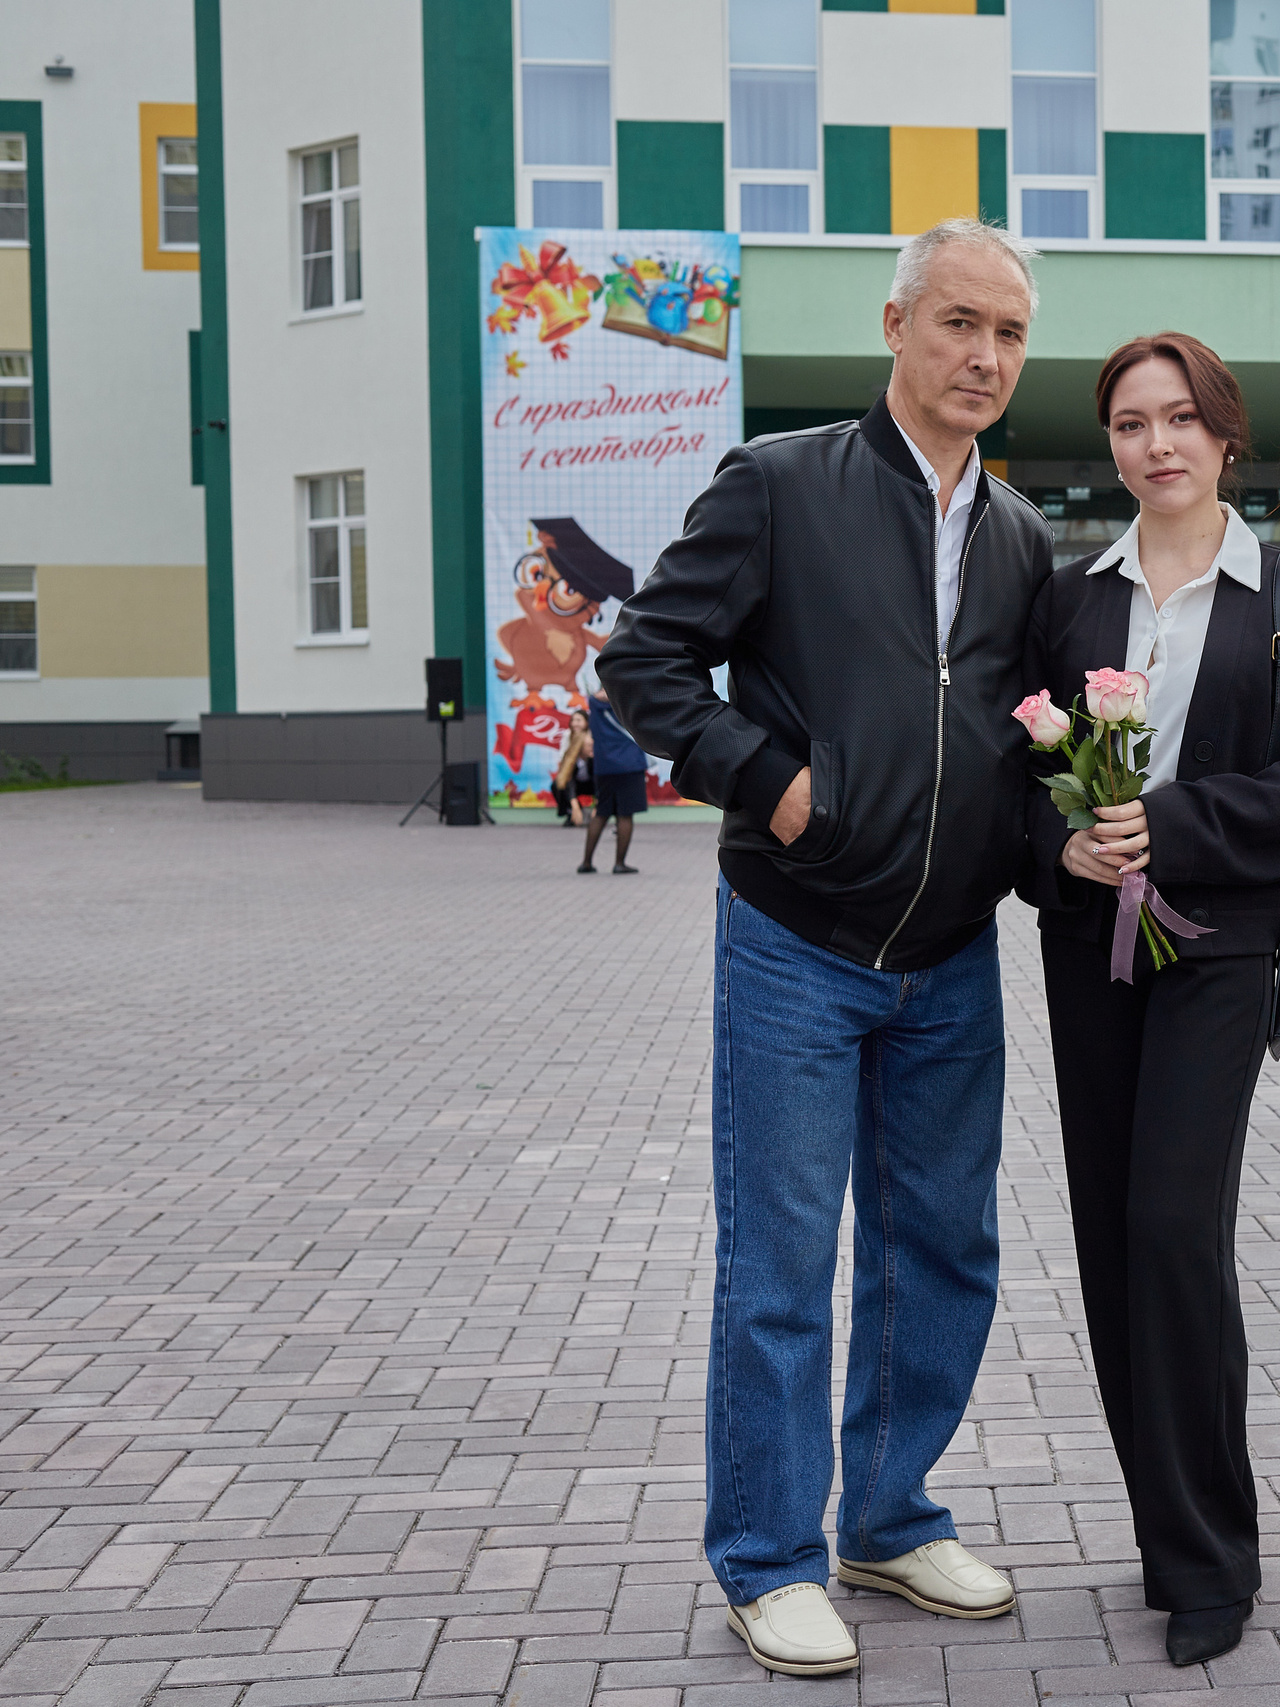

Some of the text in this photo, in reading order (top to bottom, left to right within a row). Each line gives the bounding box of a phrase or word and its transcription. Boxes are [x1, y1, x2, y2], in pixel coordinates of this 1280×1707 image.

[493, 377, 730, 435] С праздником!
[519, 424, 706, 470] 1 сентября
